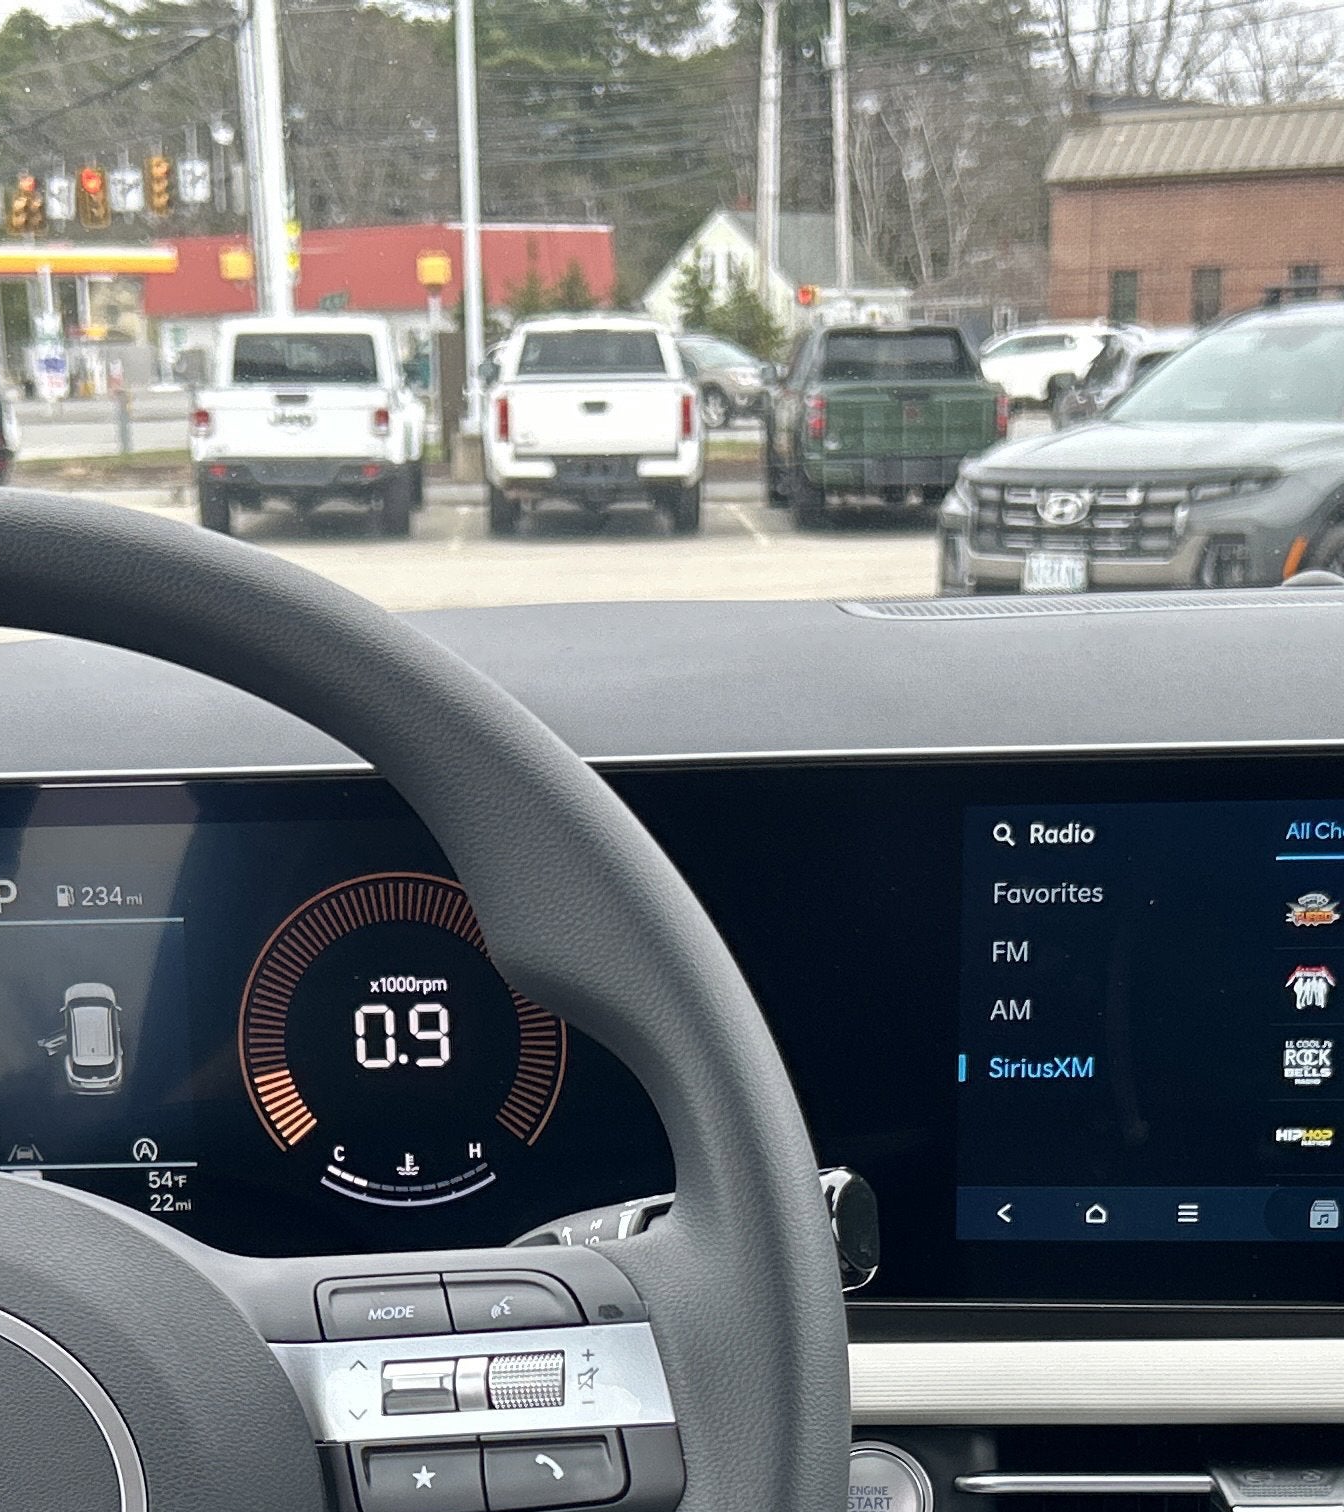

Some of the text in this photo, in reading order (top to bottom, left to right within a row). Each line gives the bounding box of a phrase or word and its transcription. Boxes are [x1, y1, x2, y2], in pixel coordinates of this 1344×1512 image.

[1029, 823, 1095, 845] Radio
[1286, 821, 1309, 840] All
[81, 886, 143, 906] 234 mi
[993, 882, 1103, 903] Favorites
[992, 942, 1028, 962] FM
[370, 978, 447, 996] x1000rpm
[990, 1000, 1031, 1021] AM
[355, 1003, 451, 1068] 0.9
[989, 1055, 1093, 1079] SiriusXM
[1285, 1049, 1331, 1066] ROCK
[333, 1145, 345, 1162] C
[468, 1143, 481, 1159] H
[367, 1305, 415, 1320] MODE
[849, 1486, 888, 1496] ENGINE
[847, 1497, 892, 1510] START
